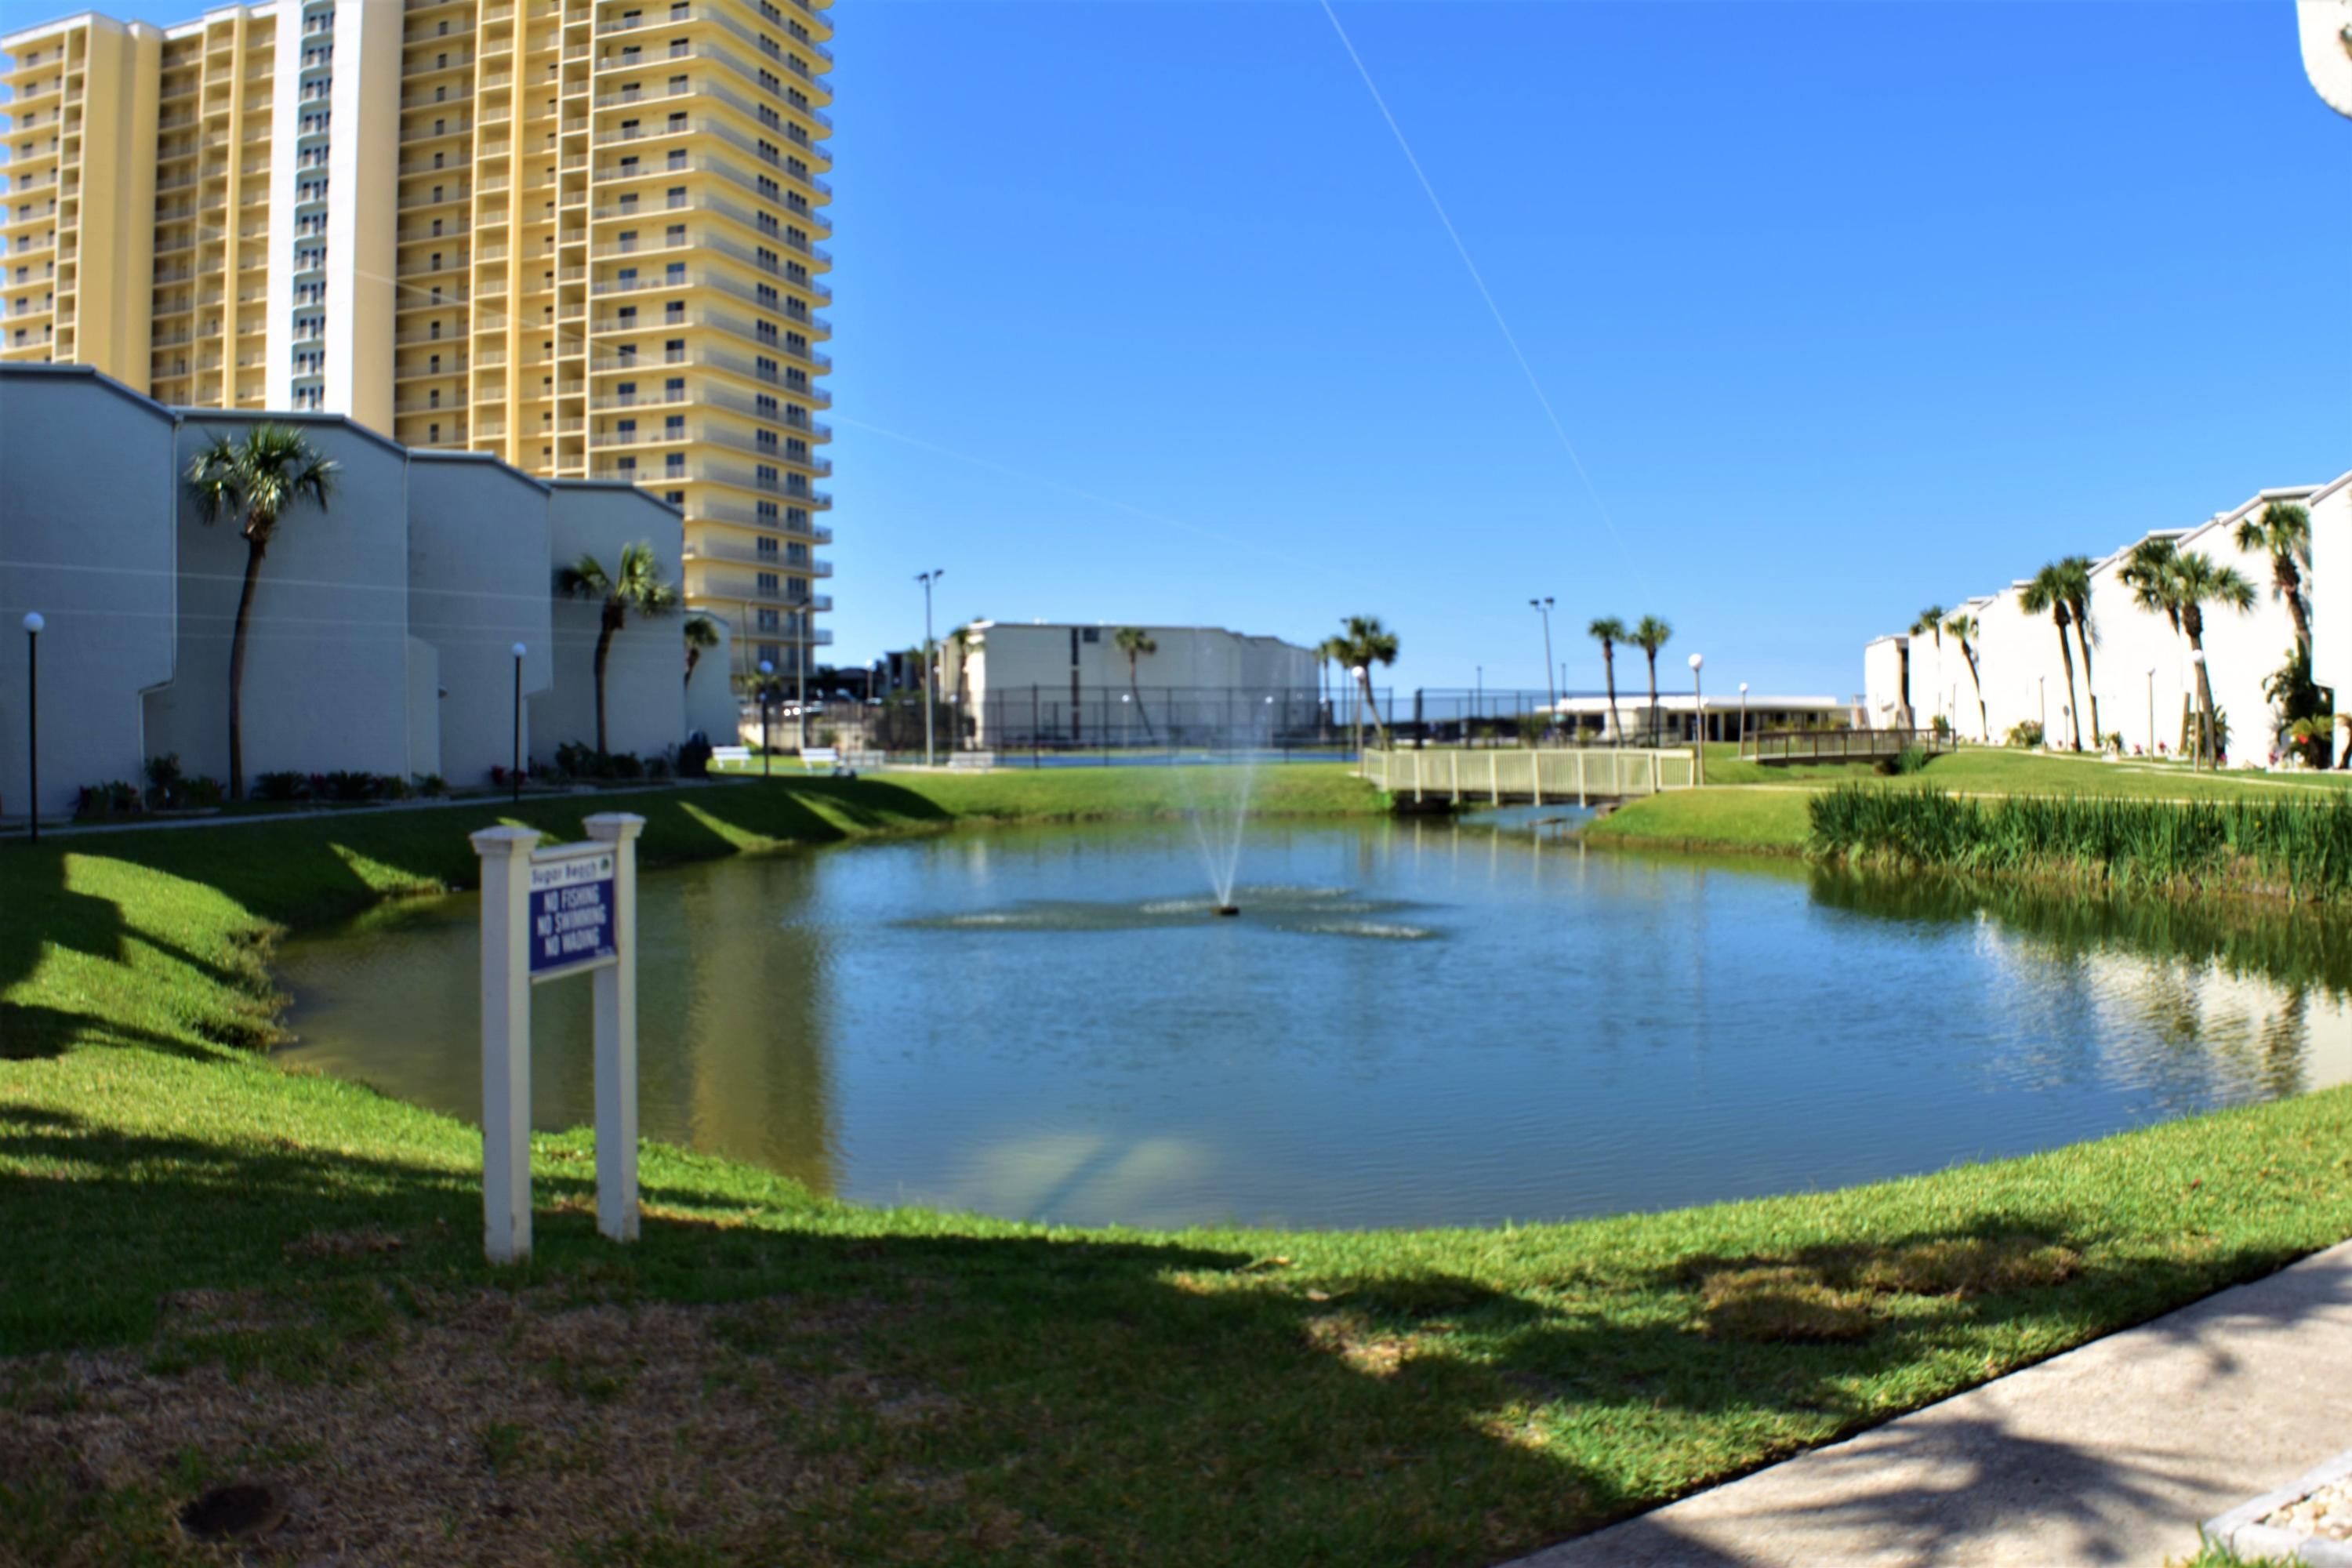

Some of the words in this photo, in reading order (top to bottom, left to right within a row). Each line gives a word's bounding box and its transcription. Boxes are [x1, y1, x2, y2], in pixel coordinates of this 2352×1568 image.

[543, 890, 559, 912] NO
[561, 884, 600, 909] FISHING
[537, 914, 553, 937] NO
[554, 903, 606, 934] SWIMMING
[544, 934, 560, 956] NO
